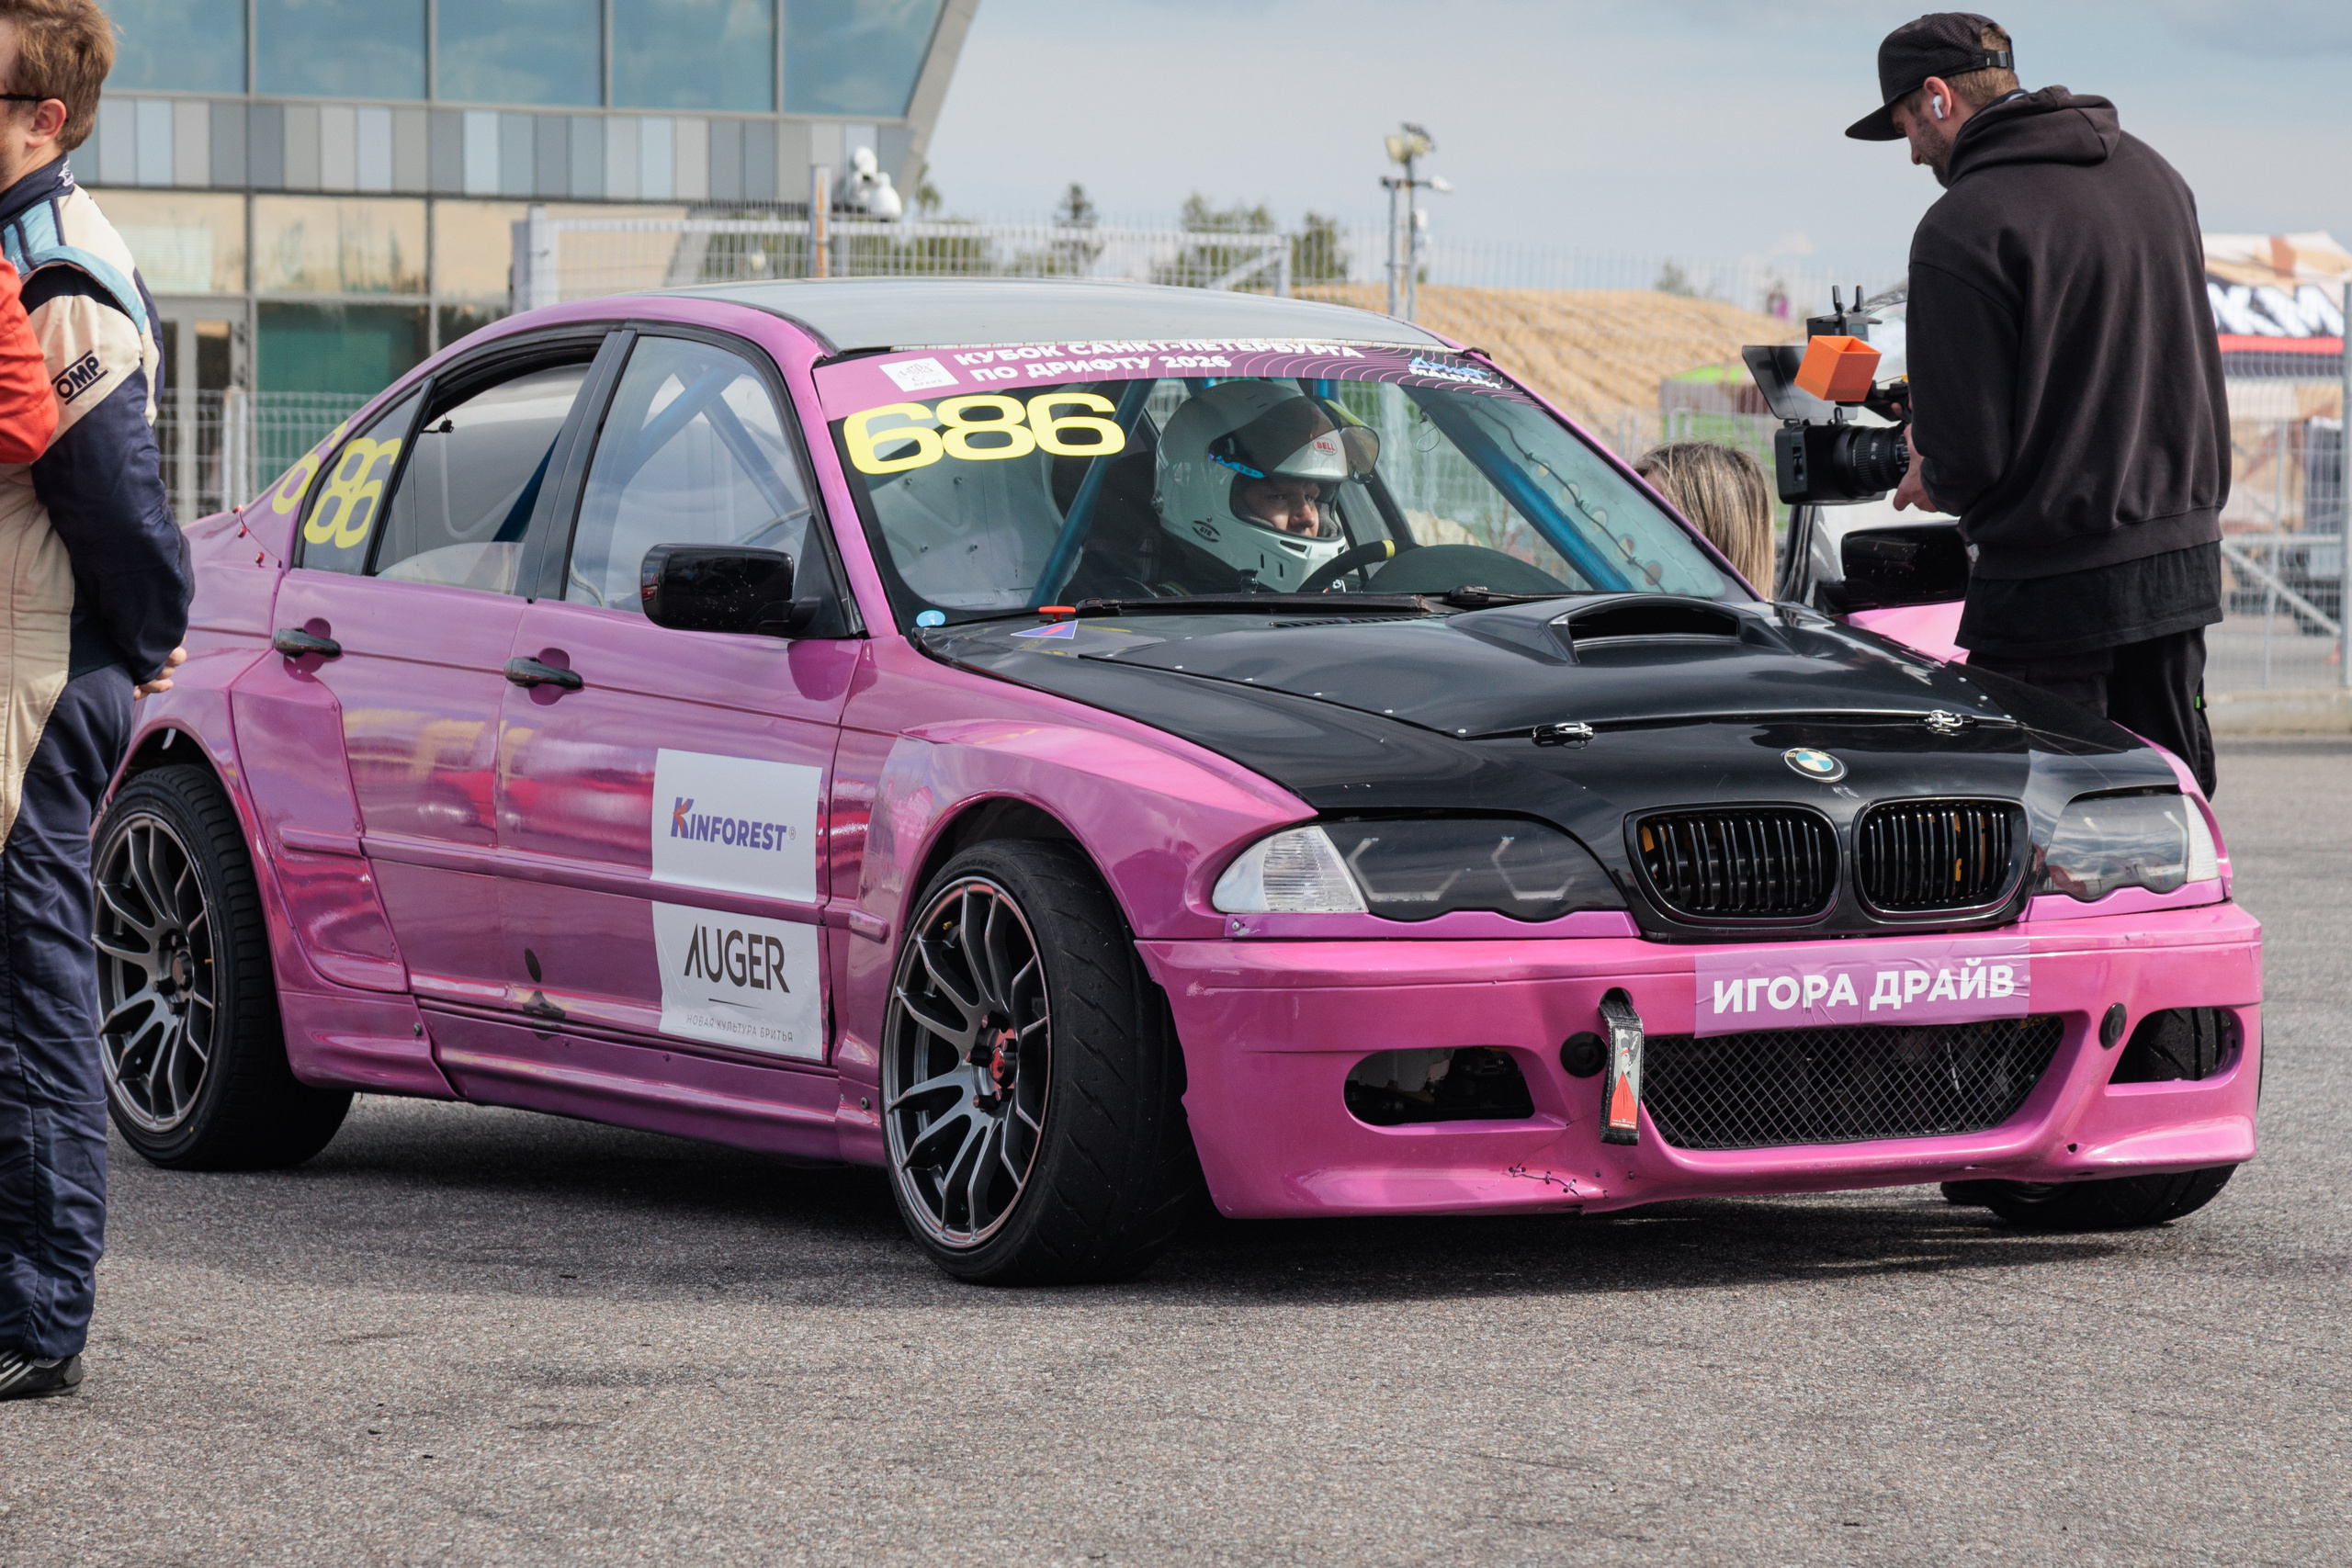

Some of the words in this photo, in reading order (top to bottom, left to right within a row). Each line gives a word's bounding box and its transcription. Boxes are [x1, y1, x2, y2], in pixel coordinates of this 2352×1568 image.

[954, 344, 1065, 366] КУБОК
[1067, 342, 1365, 358] САНКТ-ПЕТЕРБУРГА
[969, 366, 1019, 382] ПО
[1024, 356, 1149, 378] ДРИФТУ
[1159, 355, 1232, 368] 2026
[56, 355, 100, 400] OMP
[842, 392, 1125, 475] 686
[1317, 441, 1335, 451] BELL
[684, 921, 791, 994] AUGER
[1713, 973, 1859, 1014] ИГОРА
[1869, 957, 2015, 1011] ДРАЙВ
[686, 1013, 714, 1029] НОВАЯ
[717, 1020, 757, 1036] КУЛЬТУРА
[760, 1027, 794, 1043] БРИТЬЯ
